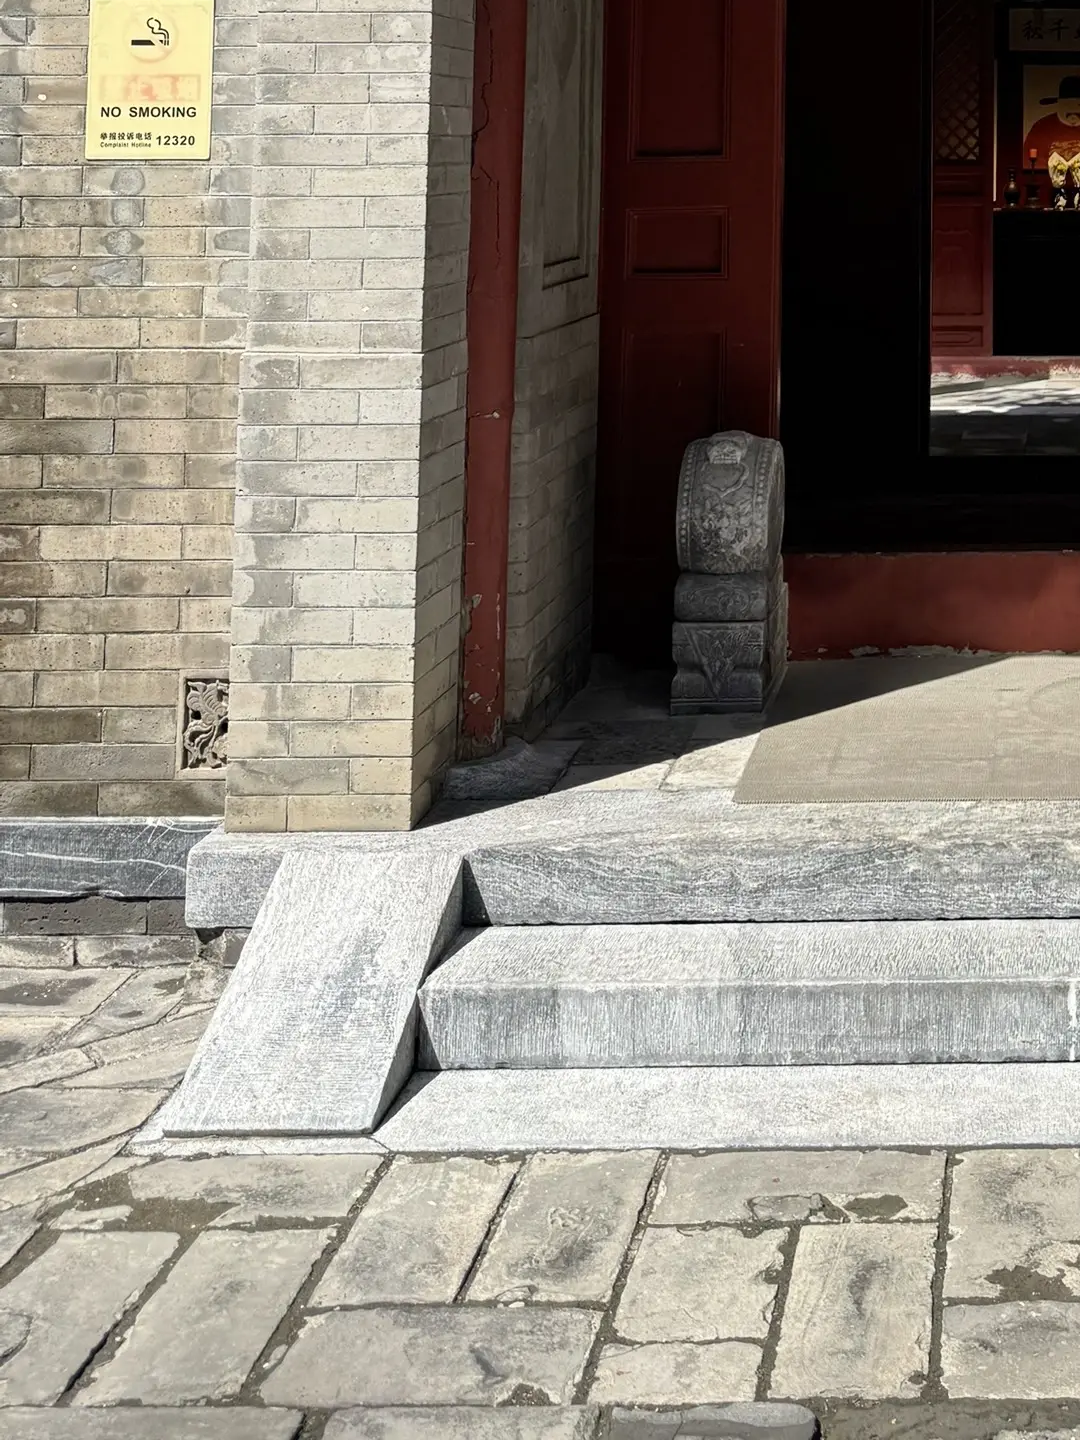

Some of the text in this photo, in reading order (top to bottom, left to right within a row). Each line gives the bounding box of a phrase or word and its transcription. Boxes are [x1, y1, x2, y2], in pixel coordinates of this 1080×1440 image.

[100, 106, 197, 118] NO SMOKING
[156, 135, 196, 146] 12320
